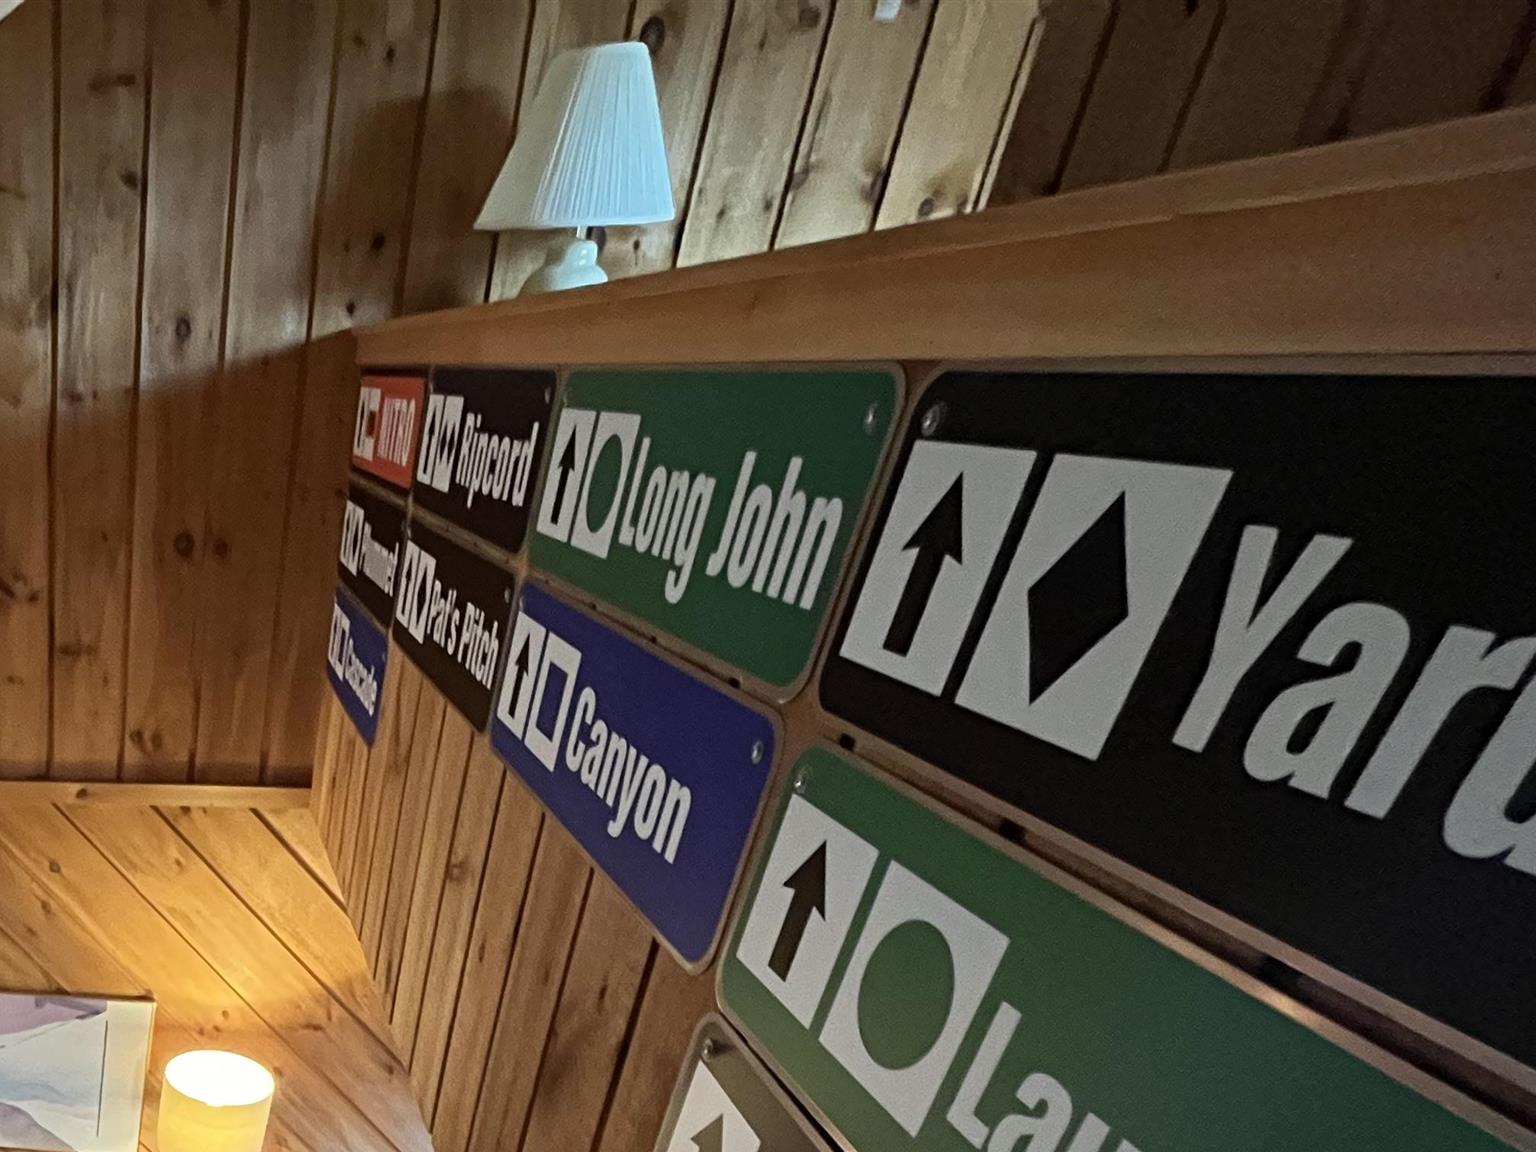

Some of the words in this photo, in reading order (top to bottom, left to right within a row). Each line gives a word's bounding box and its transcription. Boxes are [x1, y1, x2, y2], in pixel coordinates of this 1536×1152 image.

[377, 397, 416, 467] NITRO
[456, 412, 539, 509] Ripcord
[619, 437, 716, 604] Long
[706, 451, 843, 610] John
[427, 579, 460, 656] Pat's
[458, 601, 499, 691] Pitch
[565, 686, 691, 864] Canyon
